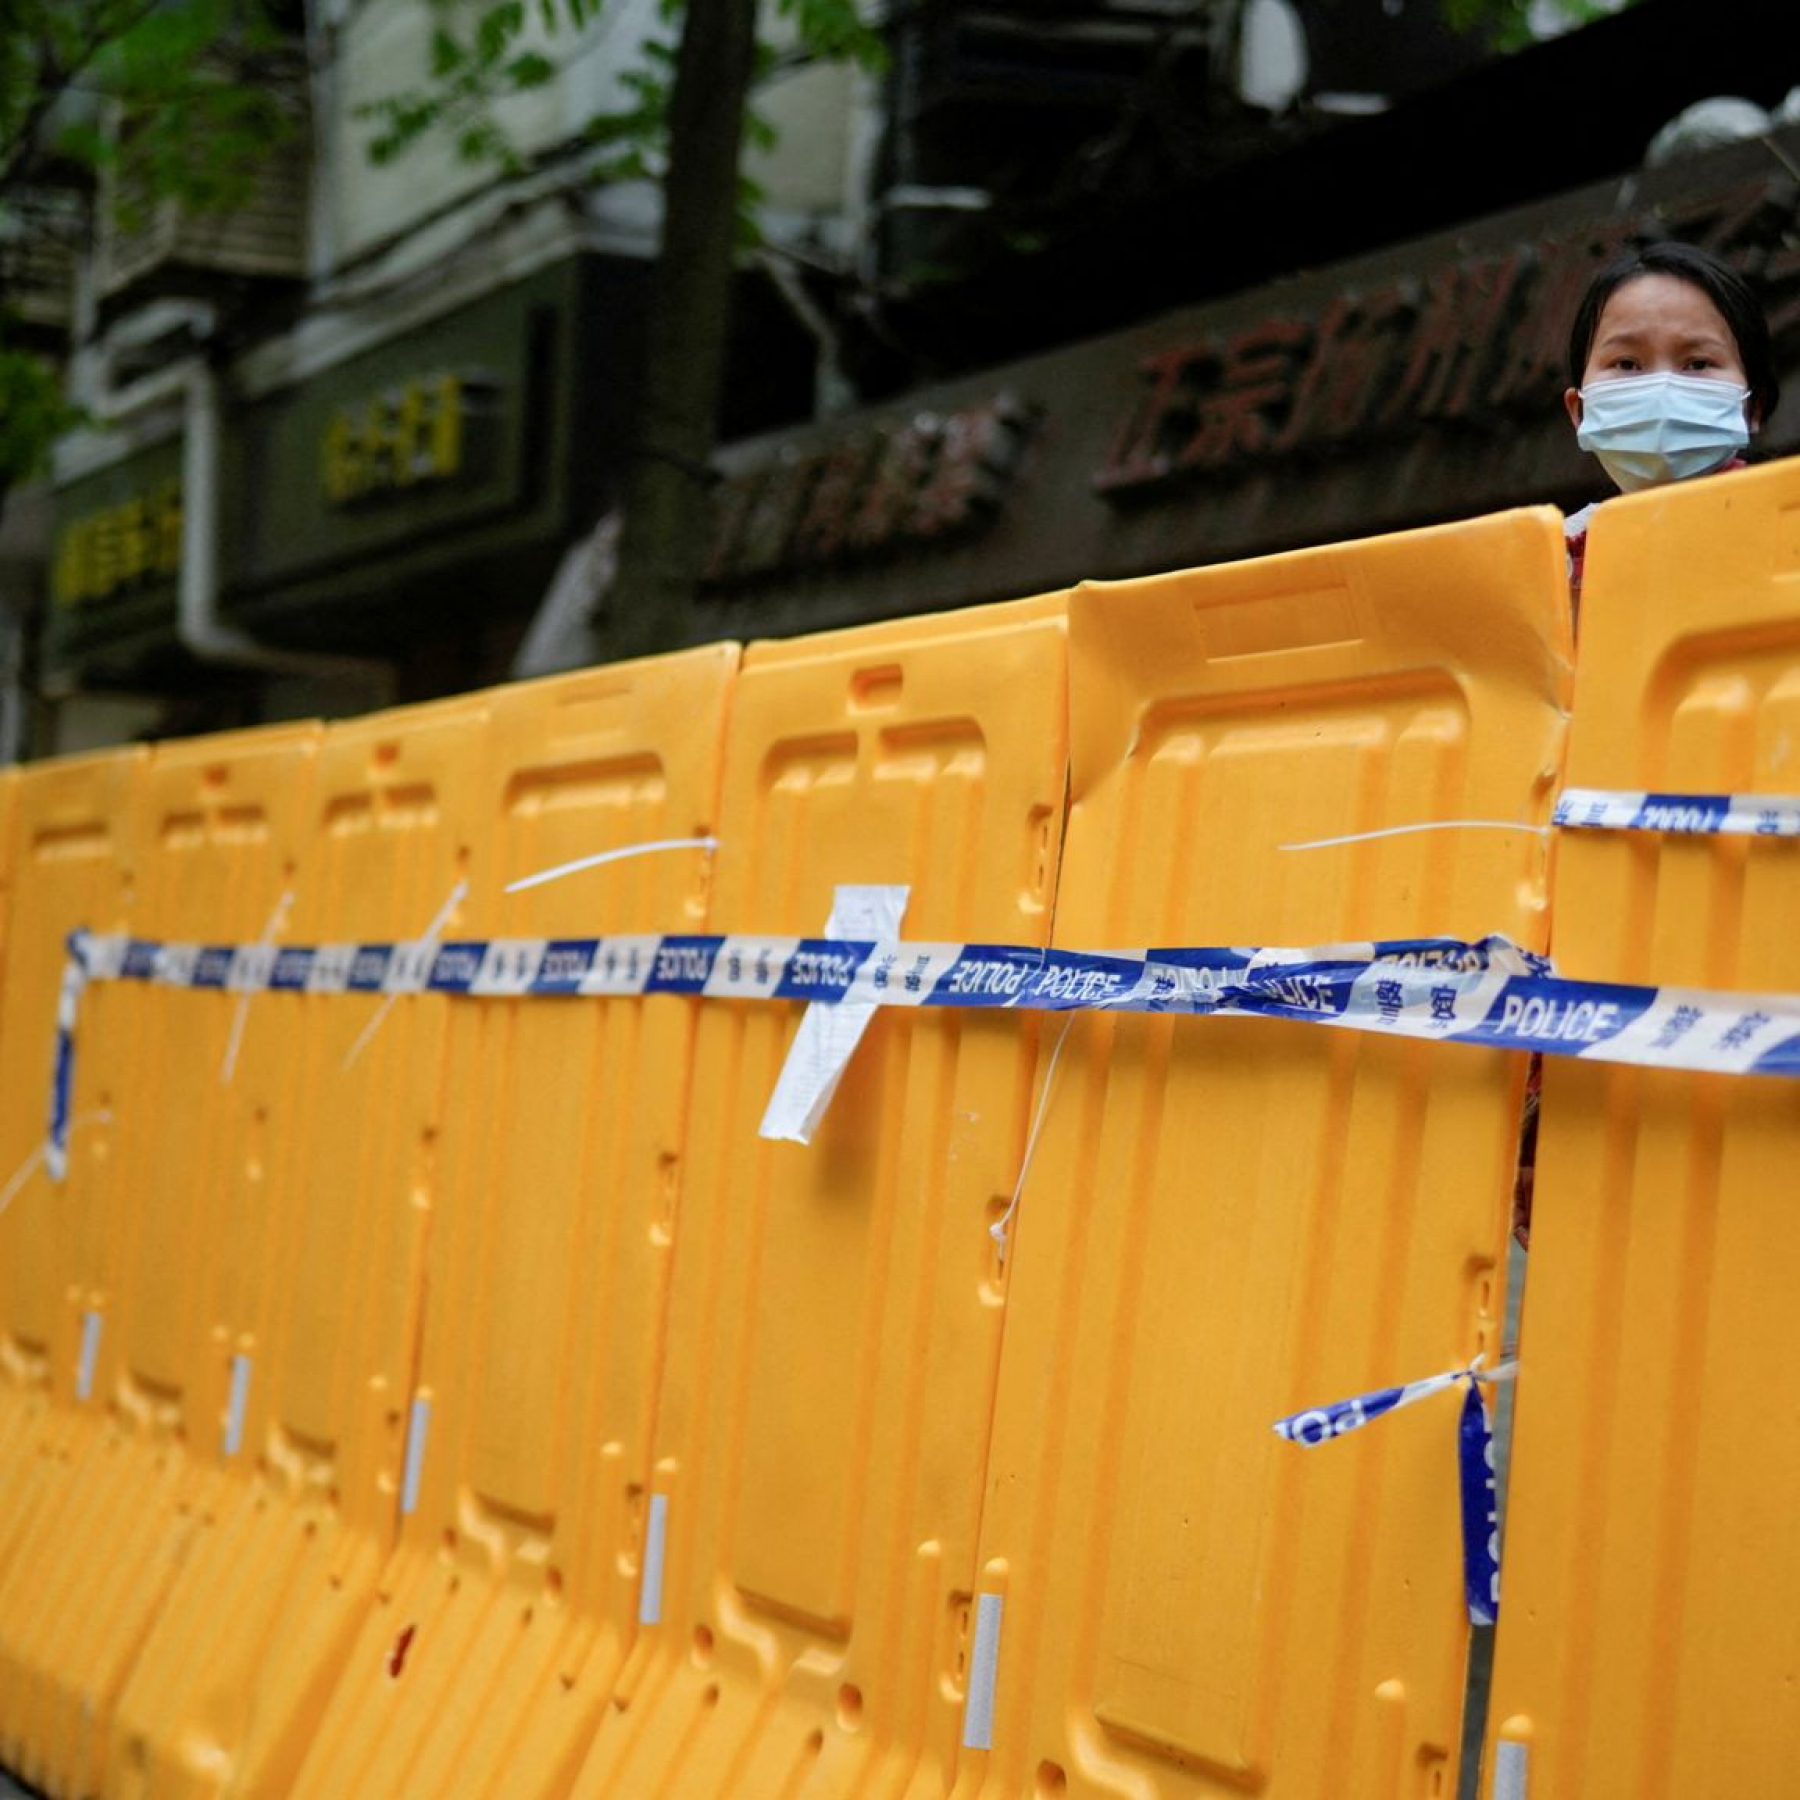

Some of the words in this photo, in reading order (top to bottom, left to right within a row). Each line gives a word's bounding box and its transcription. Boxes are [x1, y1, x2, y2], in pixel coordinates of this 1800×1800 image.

[791, 953, 857, 986] POLICE
[950, 961, 1028, 994] POLICE
[1040, 966, 1122, 1000] POLICE
[1495, 995, 1618, 1042] POLICE
